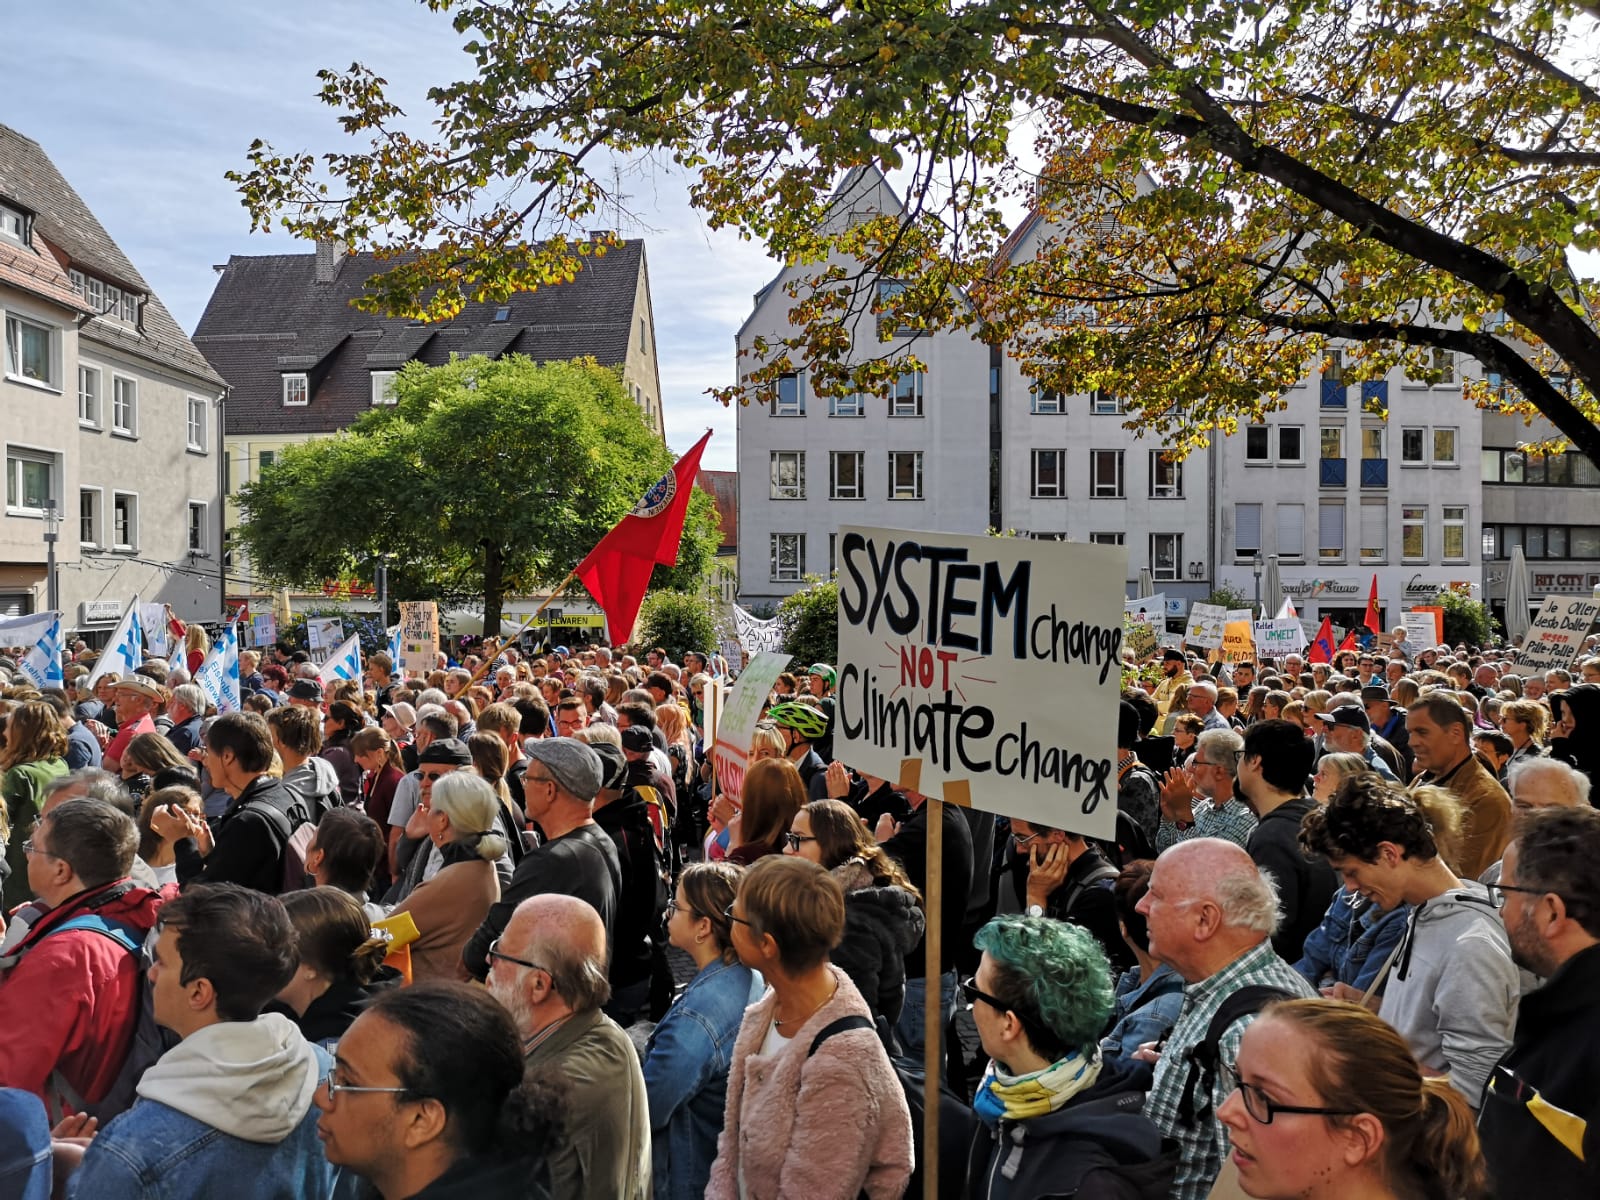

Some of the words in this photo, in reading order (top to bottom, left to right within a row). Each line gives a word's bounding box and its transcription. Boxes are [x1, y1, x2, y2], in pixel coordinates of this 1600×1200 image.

[1557, 574, 1584, 586] CITY
[840, 533, 1032, 659] SYSTEM
[1031, 604, 1123, 685] change
[1545, 601, 1558, 613] Je
[1567, 601, 1597, 616] Oller
[537, 616, 588, 625] SPELWAREN
[1534, 616, 1559, 629] desto
[1265, 628, 1297, 641] UMWELT
[901, 644, 958, 691] NOT
[839, 663, 995, 773] Climate
[996, 722, 1112, 815] change
